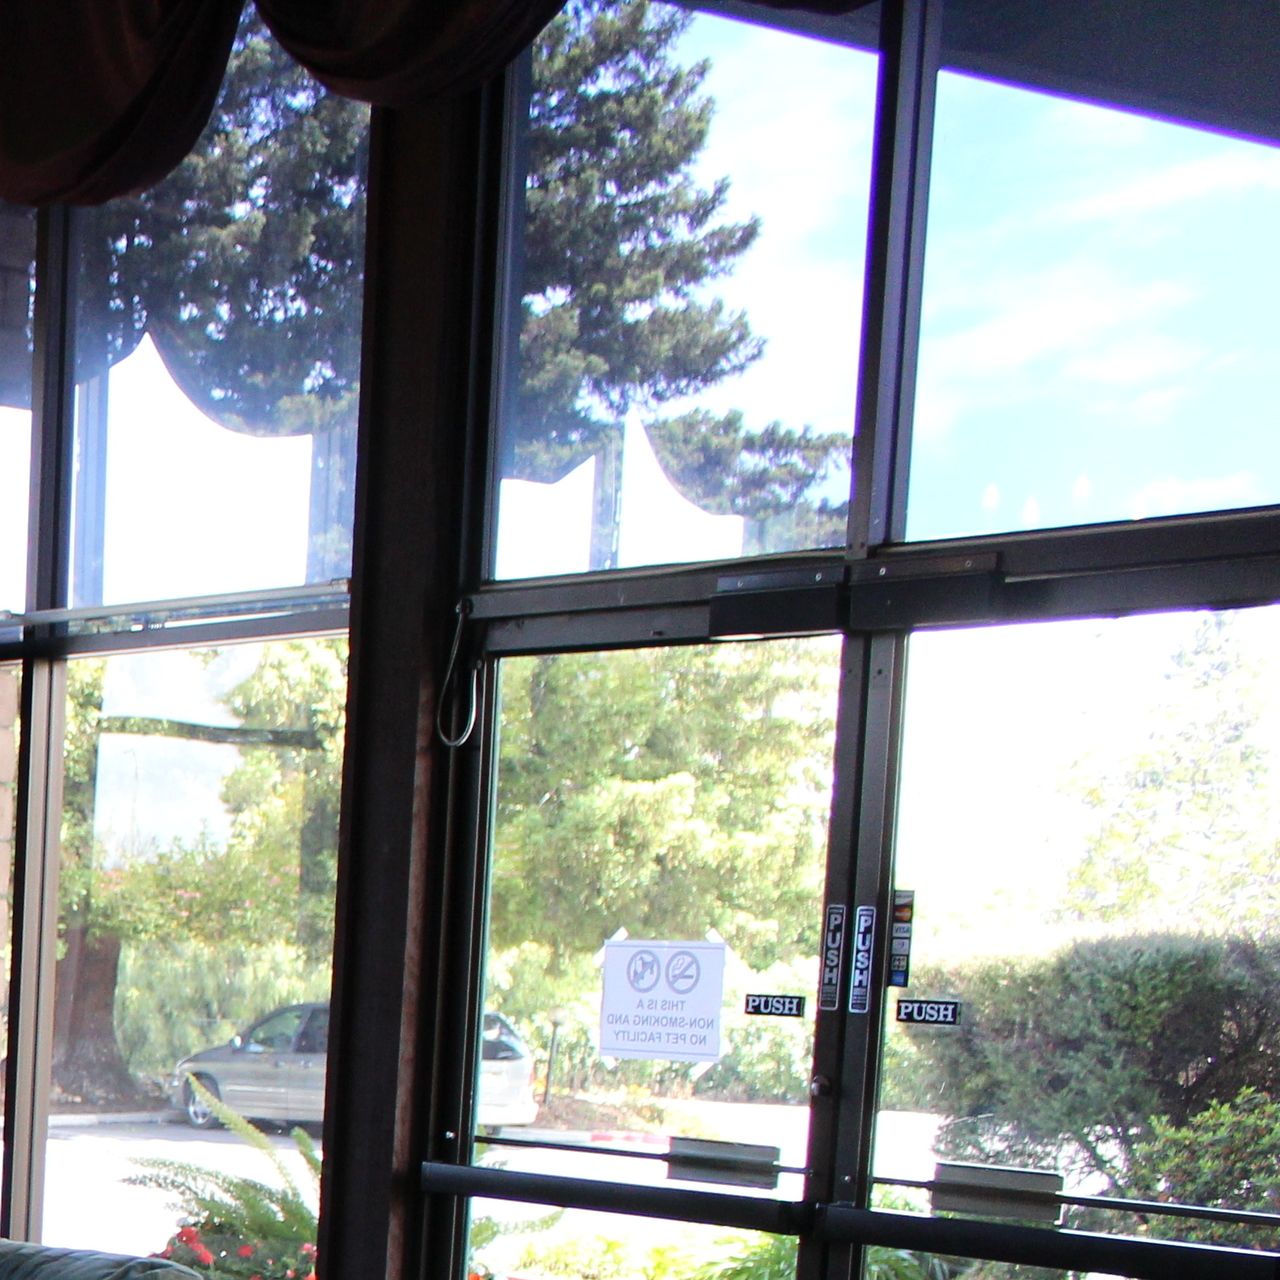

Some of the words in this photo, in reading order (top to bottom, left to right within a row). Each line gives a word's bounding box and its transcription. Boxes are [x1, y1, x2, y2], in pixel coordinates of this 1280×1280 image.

[824, 914, 842, 984] PUSH
[855, 916, 872, 987] PUSH
[746, 996, 799, 1016] PUSH
[898, 1003, 954, 1022] PUSH
